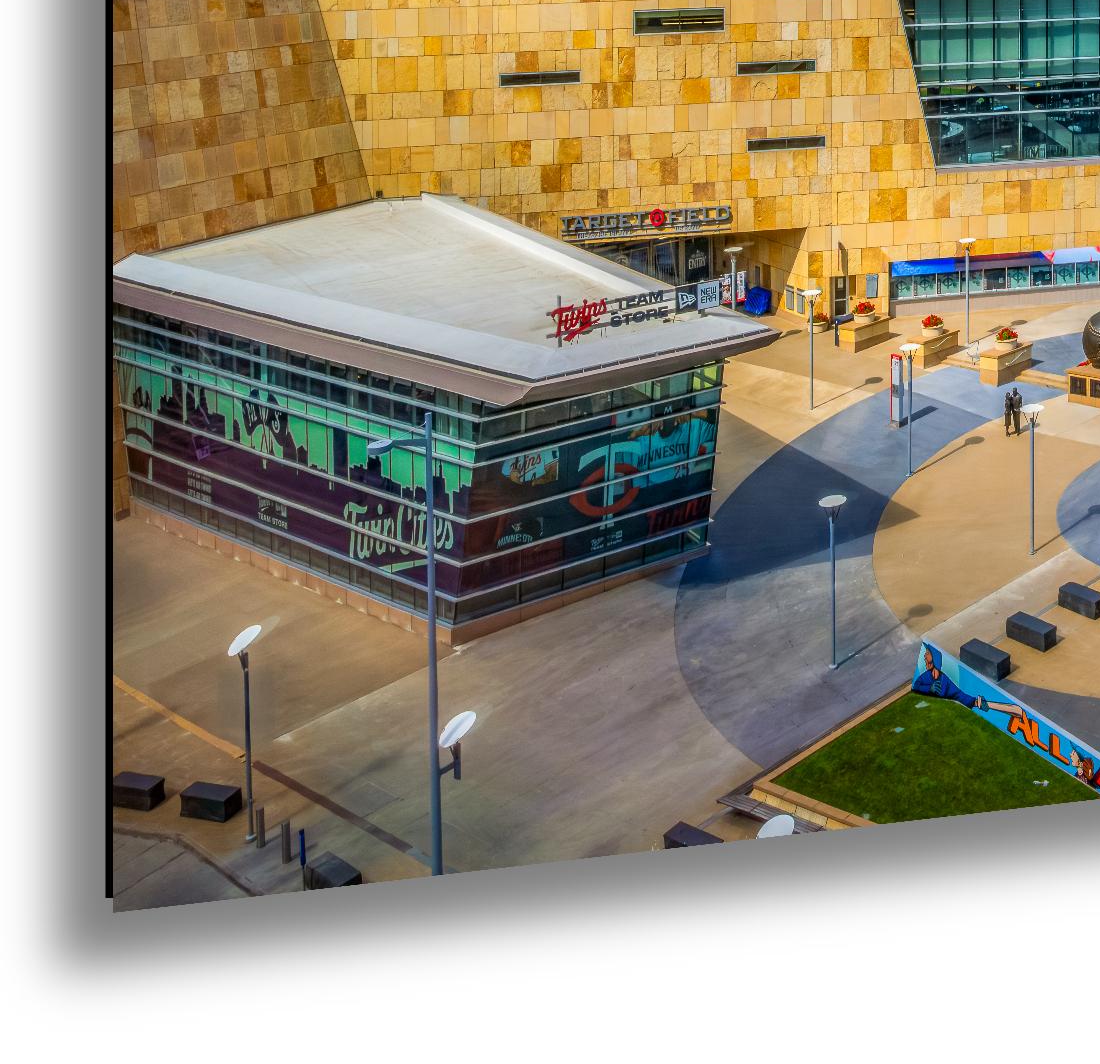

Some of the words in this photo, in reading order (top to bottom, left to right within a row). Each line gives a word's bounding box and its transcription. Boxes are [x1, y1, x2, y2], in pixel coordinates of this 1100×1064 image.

[560, 212, 645, 231] TARGET
[668, 206, 731, 223] FIELD
[688, 256, 707, 269] ENTRY
[616, 290, 664, 310] TEAM
[701, 286, 717, 296] NEW
[701, 294, 717, 304] ERA
[551, 298, 608, 341] Twins
[610, 306, 669, 327] STORE
[1008, 709, 1070, 765] ALL
